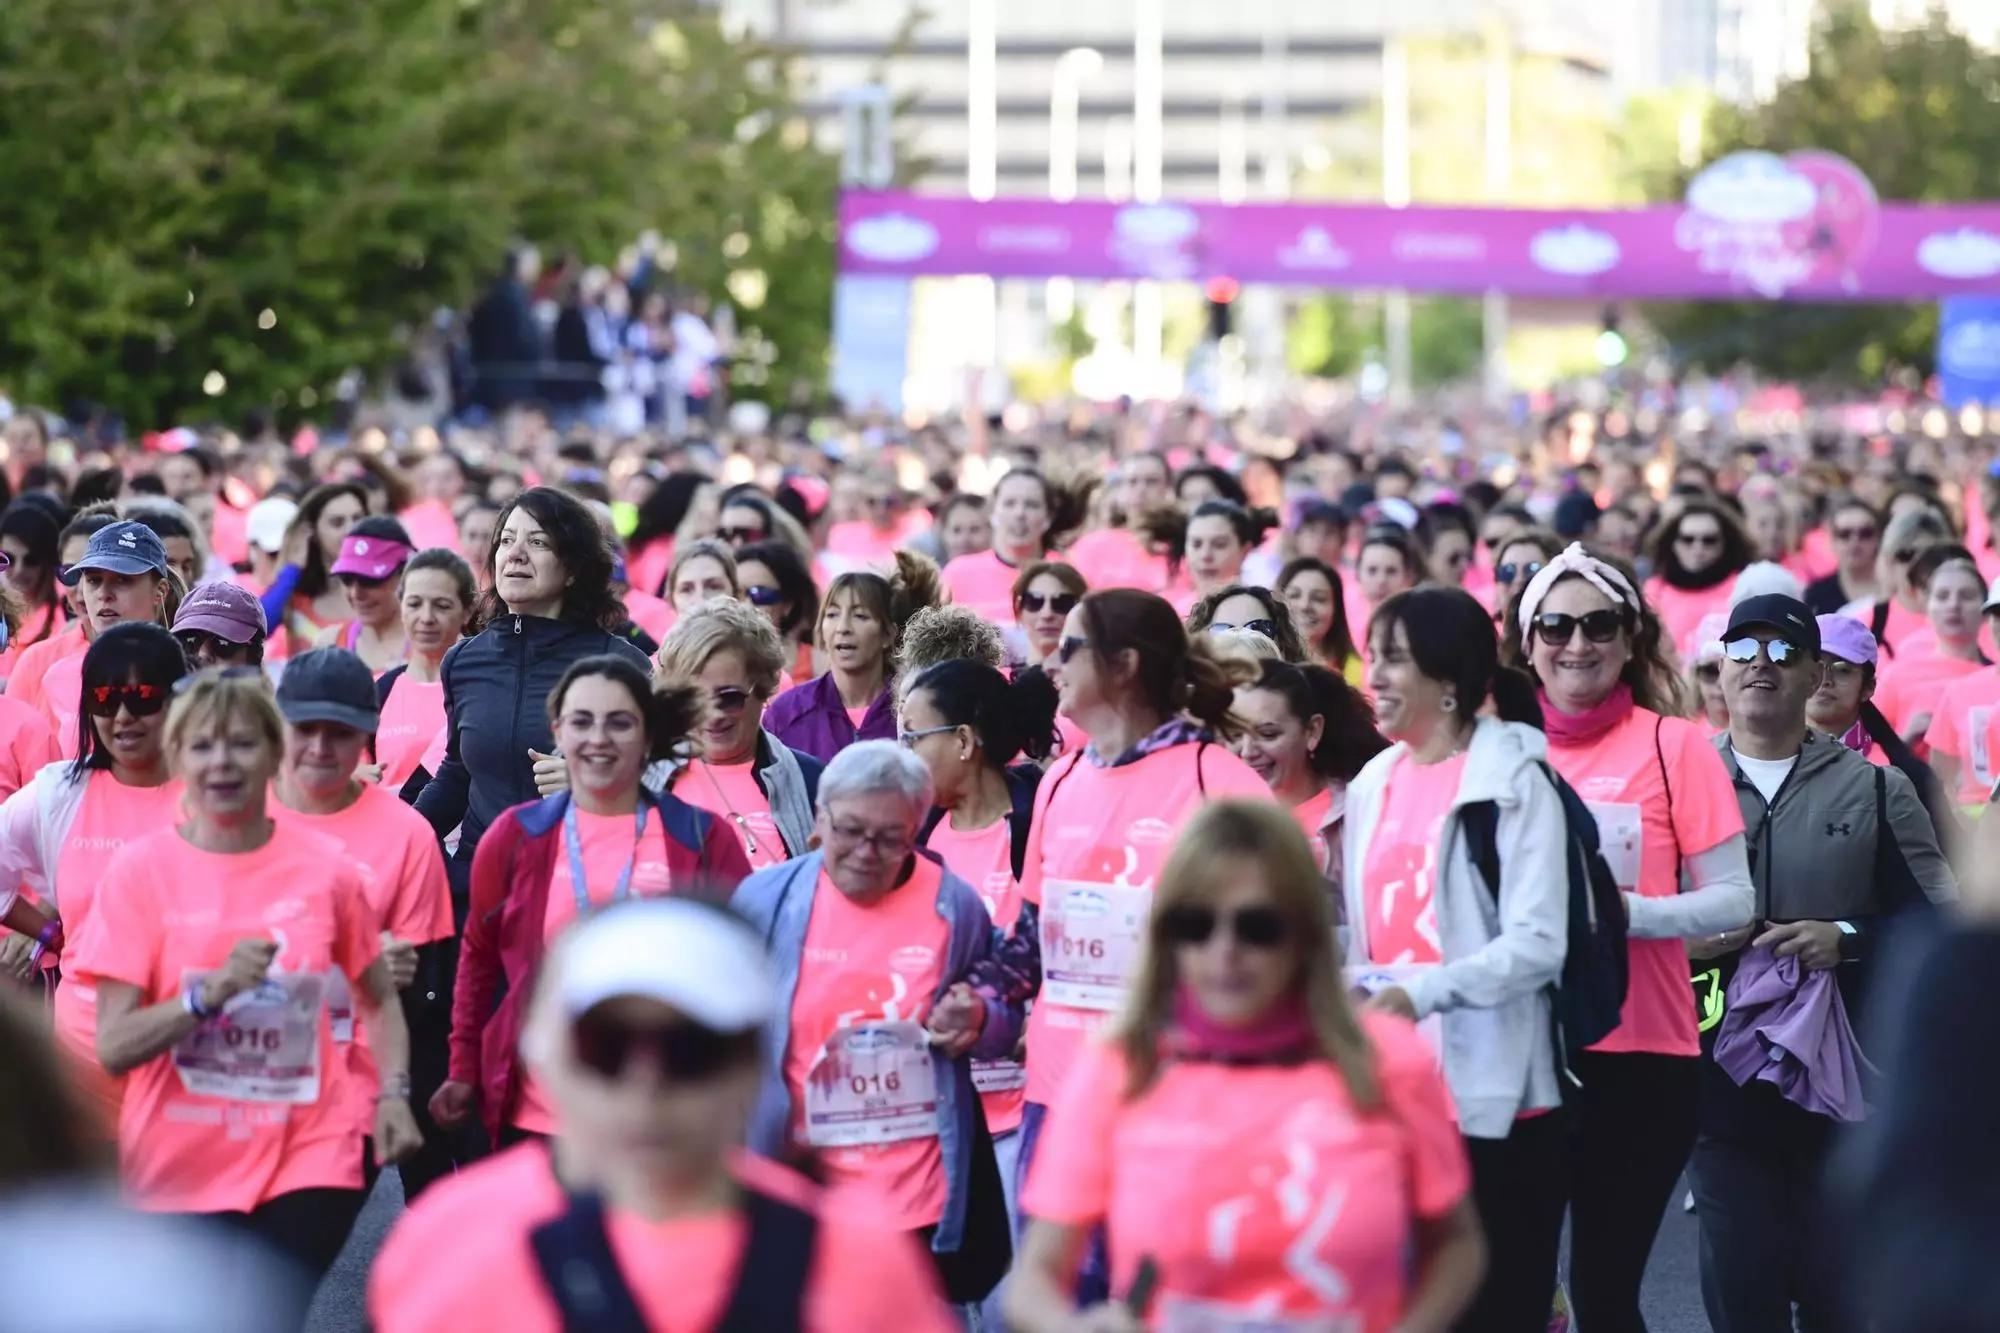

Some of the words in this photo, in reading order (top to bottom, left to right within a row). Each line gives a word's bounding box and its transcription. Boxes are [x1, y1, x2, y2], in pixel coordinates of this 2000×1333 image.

[71, 837, 125, 850] OYSHO
[1063, 936, 1105, 959] 016
[223, 1025, 281, 1053] 016
[851, 1070, 902, 1095] 016
